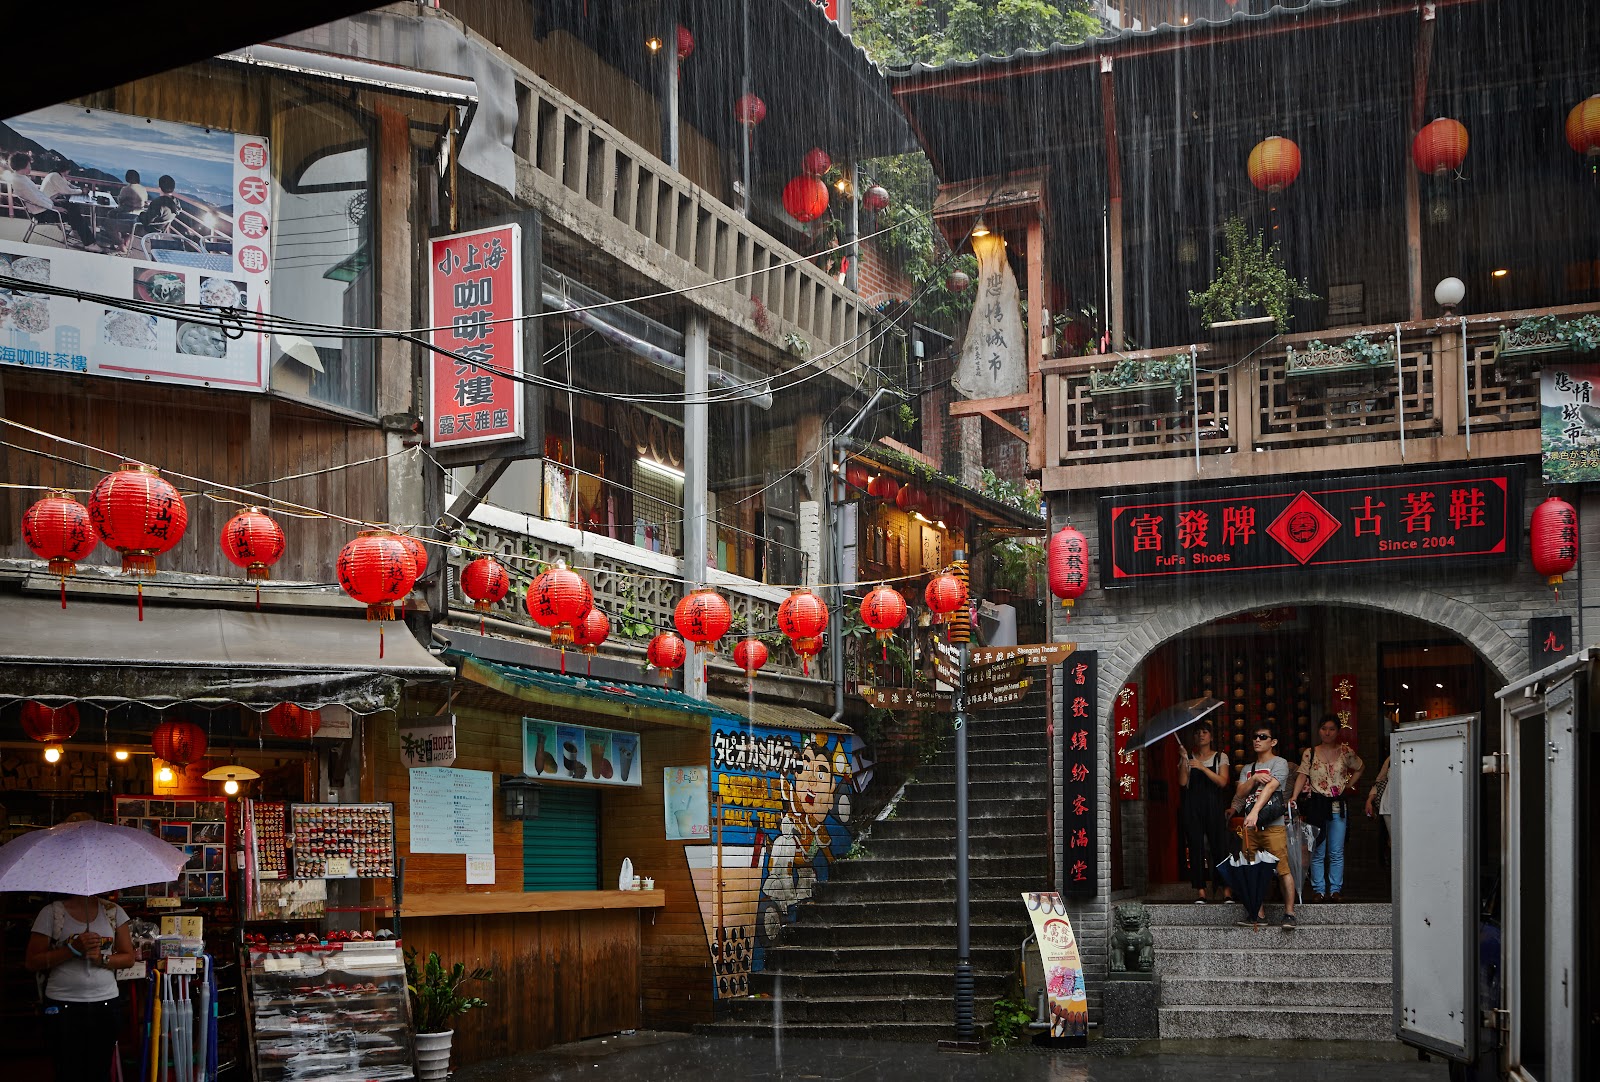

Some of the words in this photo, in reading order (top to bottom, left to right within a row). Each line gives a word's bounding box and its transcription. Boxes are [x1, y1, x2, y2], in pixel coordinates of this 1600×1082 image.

[241, 144, 266, 271] 露天景觀
[438, 238, 507, 276] 小上海
[453, 277, 494, 407] 咖啡茶樓
[985, 272, 1007, 383] 悲情城市
[439, 408, 508, 435] 露天雅座
[1555, 371, 1593, 444] 悲情城市
[1130, 506, 1256, 553] 富發牌
[1350, 488, 1486, 537] 古著鞋
[1155, 555, 1186, 566] FuFa
[1193, 553, 1231, 564] Shoes
[1379, 540, 1418, 551] Since
[1422, 536, 1455, 549] 2004
[401, 732, 425, 764] 希望
[432, 736, 453, 750] HOPE
[433, 751, 453, 761] HOUSE
[724, 809, 753, 827] MILK
[757, 811, 781, 829] TEA
